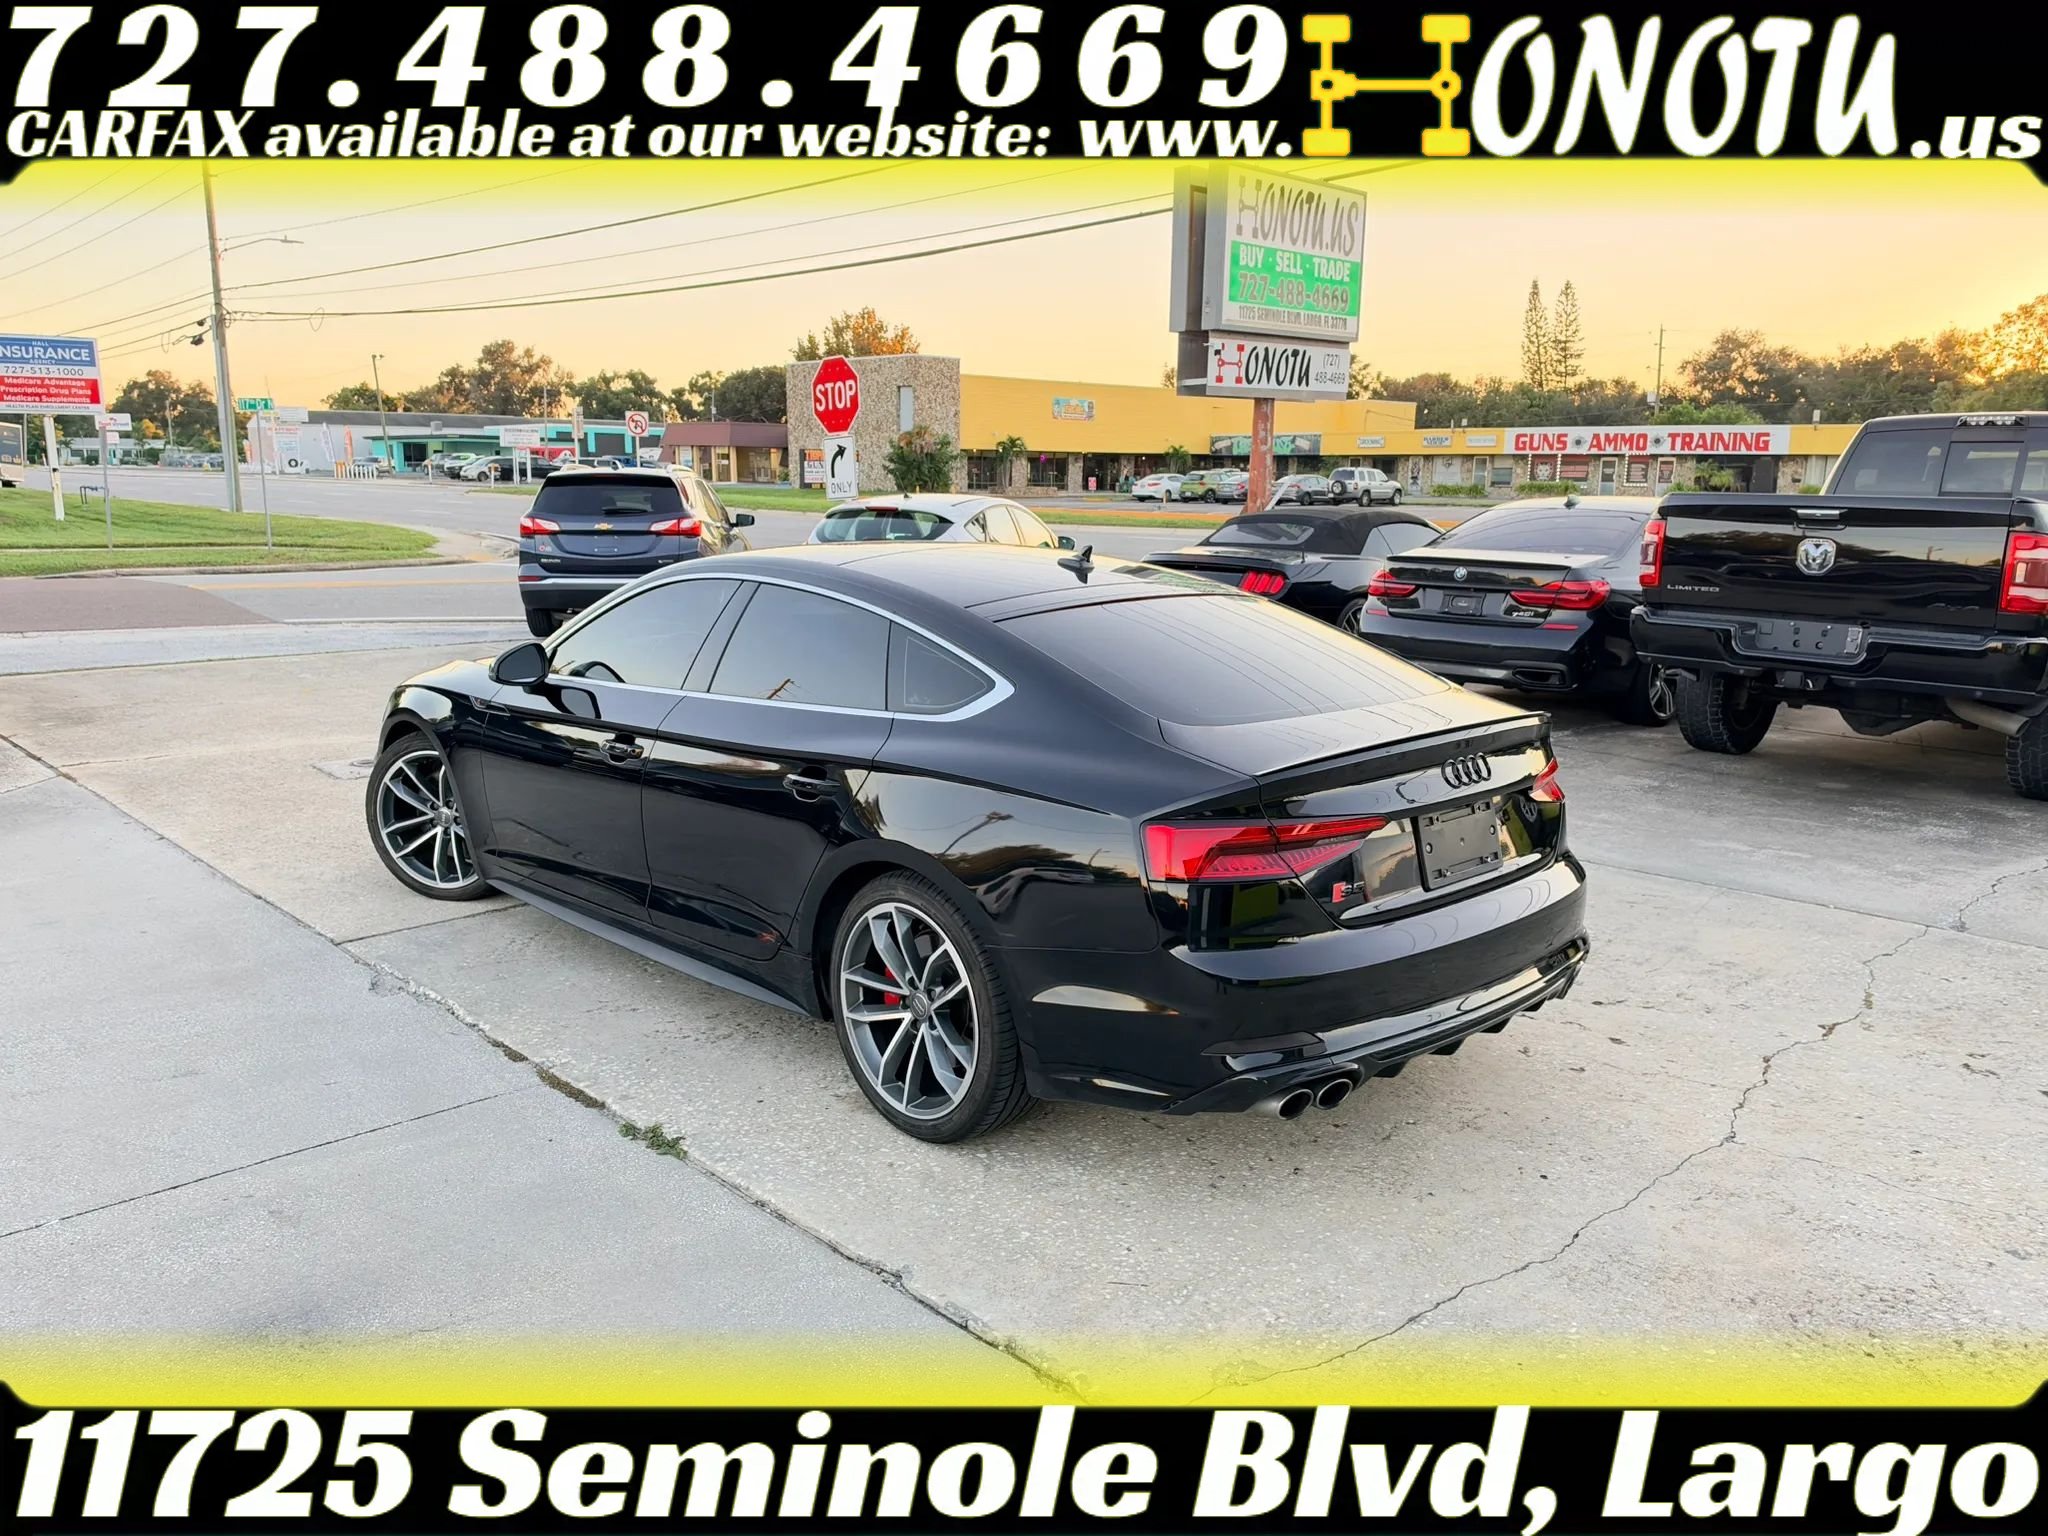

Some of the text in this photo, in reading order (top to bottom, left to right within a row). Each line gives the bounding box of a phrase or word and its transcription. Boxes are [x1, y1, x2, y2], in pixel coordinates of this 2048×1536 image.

[1239, 244, 1351, 282] BUY SELL TRADE
[1238, 272, 1349, 312] 727-488-4669
[0, 345, 90, 360] NSURANCE
[1322, 353, 1340, 369] (727)
[4, 365, 84, 376] 727-513-1000
[4, 377, 86, 387] Medicare Advantage
[0, 386, 48, 395] Prescription
[50, 387, 69, 395] Drug
[815, 379, 856, 412] STOP
[3, 394, 91, 403] Medicare Supplements
[1515, 432, 1770, 452] GUNS AMMO TRAINING
[831, 480, 852, 494] ONLY
[1667, 584, 1720, 593] LIMITED
